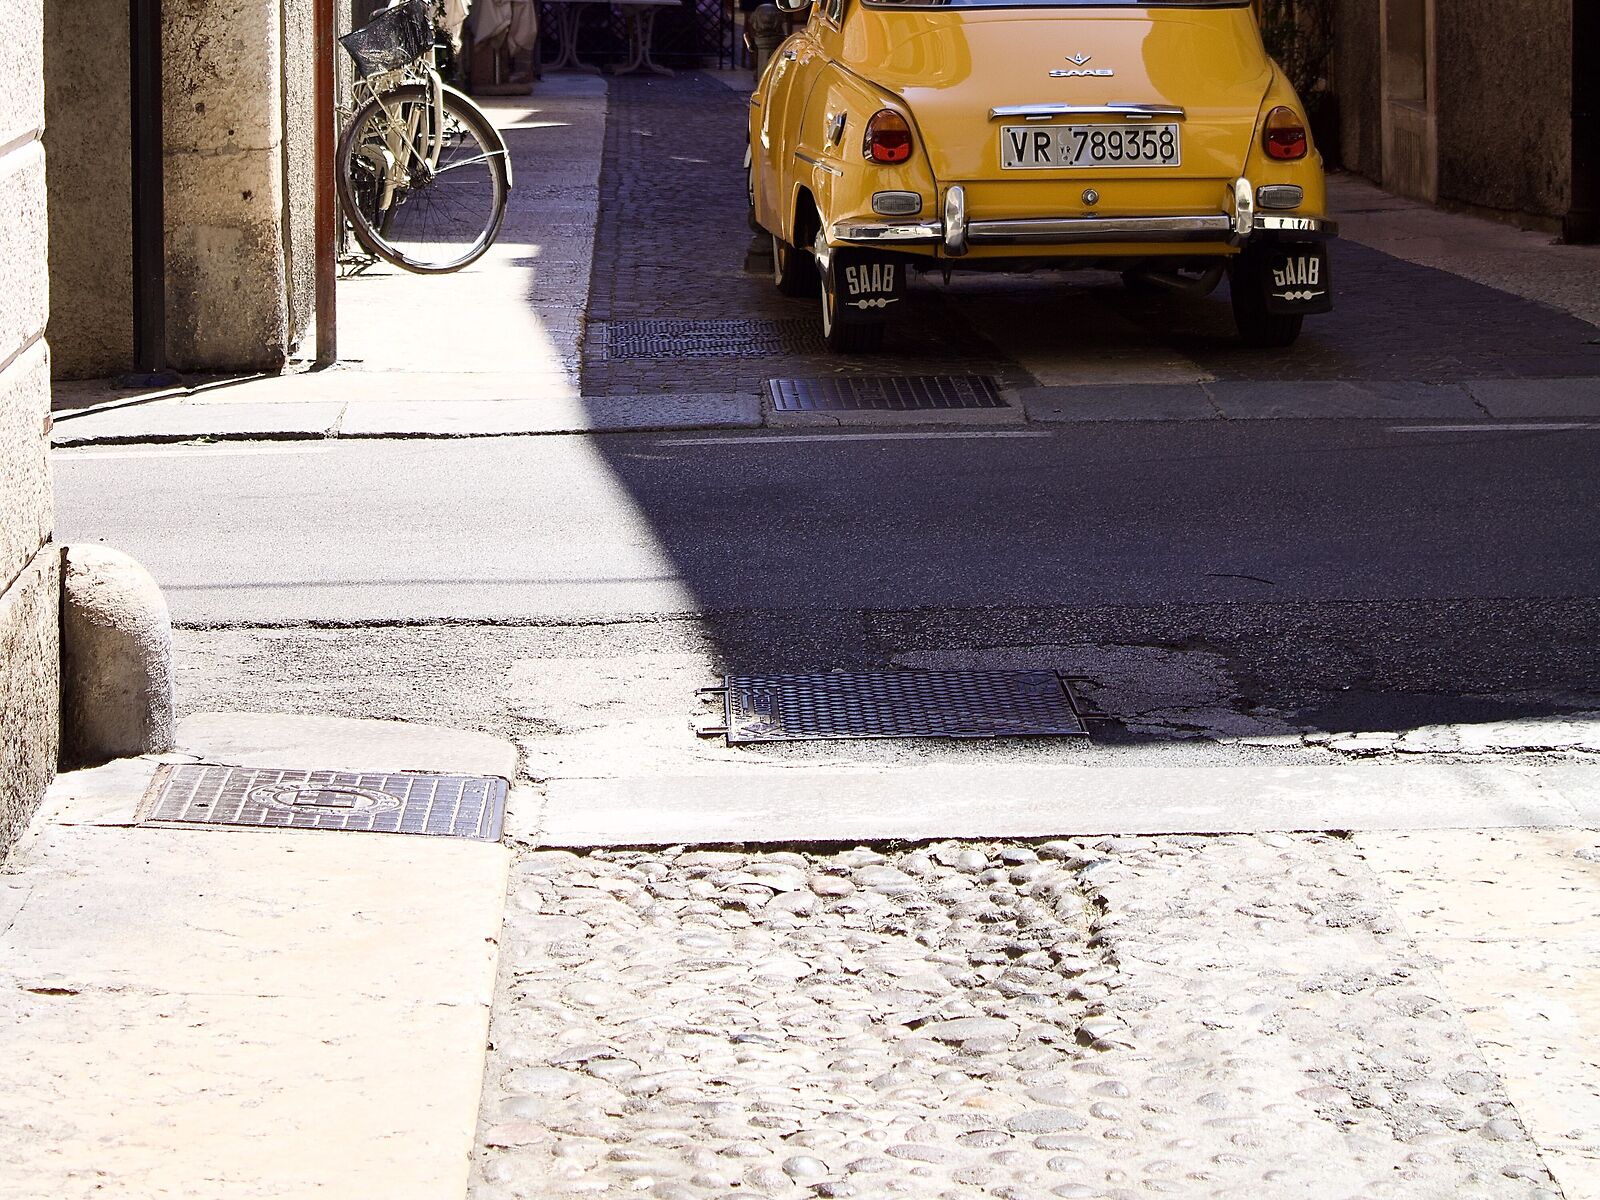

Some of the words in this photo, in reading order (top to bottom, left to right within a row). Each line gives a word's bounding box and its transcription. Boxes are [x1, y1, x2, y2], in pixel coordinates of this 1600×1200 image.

[1048, 69, 1114, 78] SAAB
[1010, 131, 1051, 163] VR
[1073, 130, 1175, 162] 789358
[845, 263, 895, 295] SAAB
